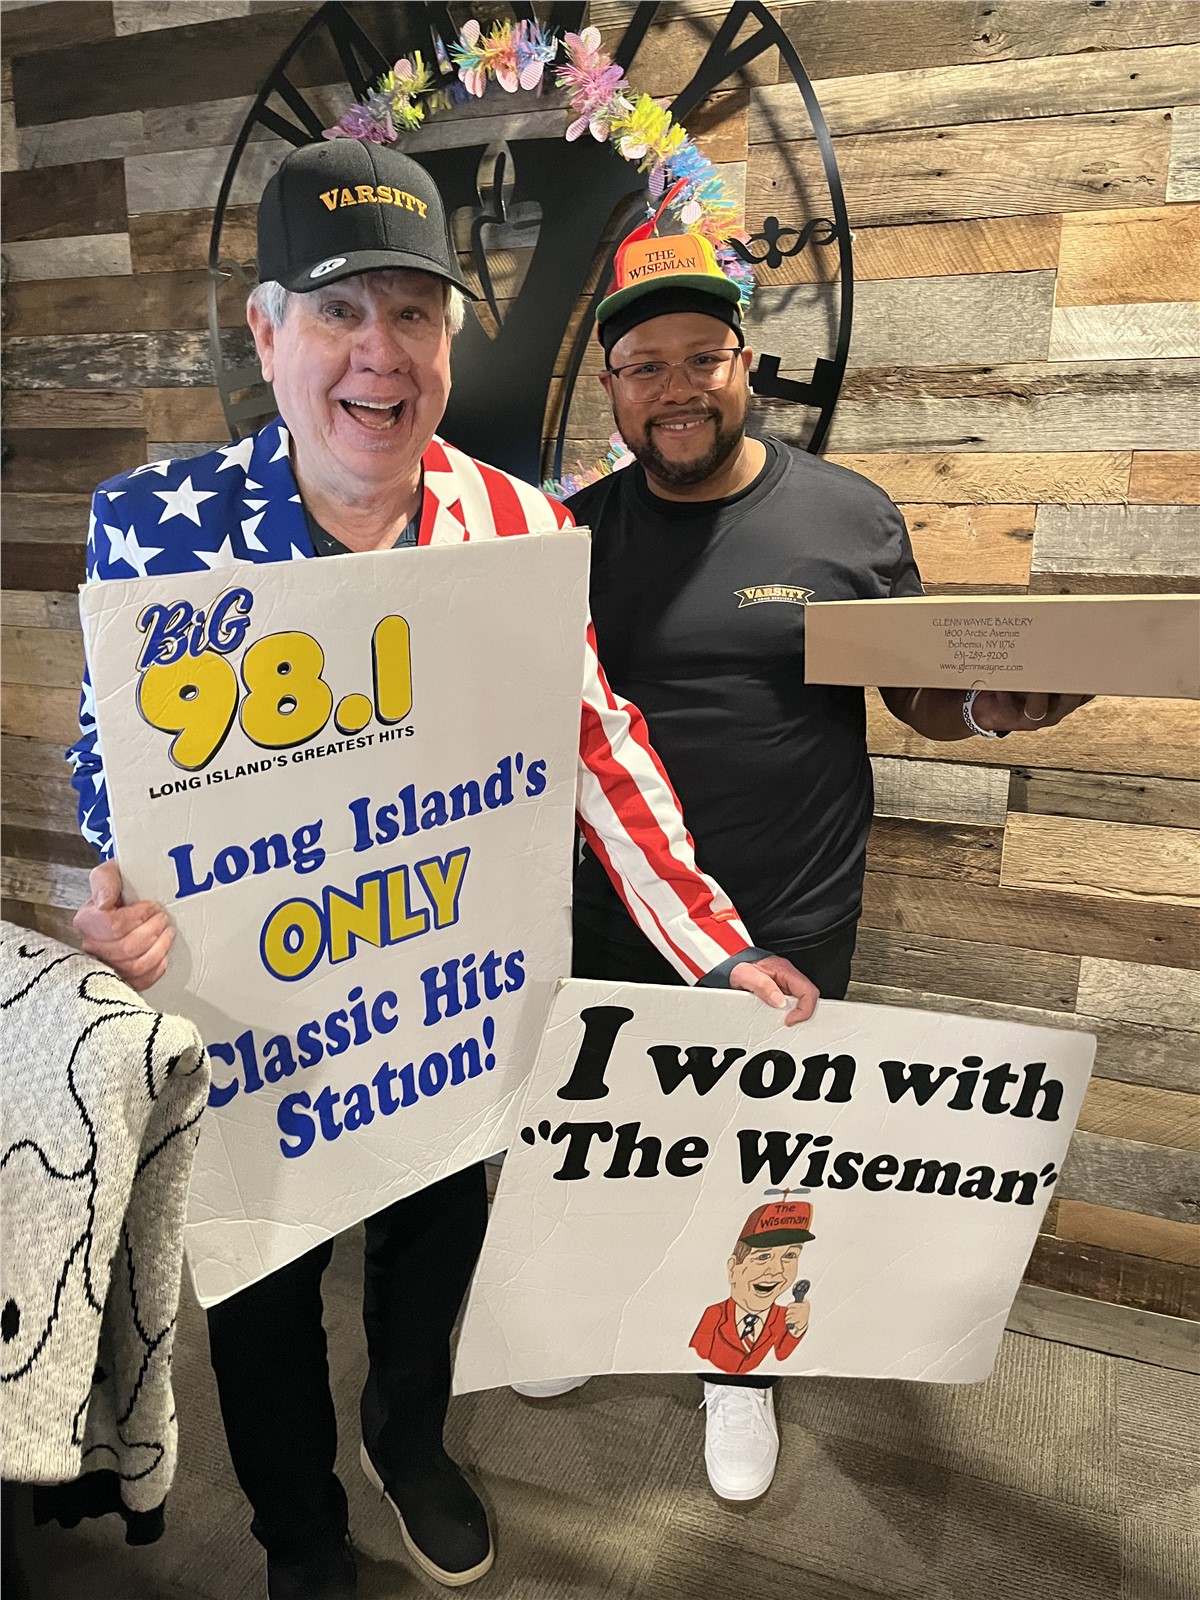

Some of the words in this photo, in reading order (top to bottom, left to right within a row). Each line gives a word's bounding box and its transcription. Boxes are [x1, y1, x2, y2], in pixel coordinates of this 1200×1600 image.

[319, 185, 428, 219] VARSITY
[645, 249, 676, 263] THE
[629, 258, 696, 280] WISEMAN
[744, 587, 805, 599] VARSITY
[932, 618, 962, 627] GLENN
[963, 617, 993, 626] WAYNE
[995, 617, 1034, 626] BAKERY
[944, 629, 963, 637] 1800
[964, 629, 988, 637] Arctic
[989, 629, 1020, 637] Avenue
[986, 640, 998, 648] NY
[940, 661, 1023, 674] www.glennwayne.com
[136, 614, 412, 771] 98.1
[149, 776, 202, 799] LONG
[206, 755, 288, 785] ISLAND'S
[291, 735, 375, 763] GREATEST
[379, 725, 415, 743] HITS
[168, 819, 326, 899] Long
[348, 752, 547, 852] Island's
[260, 846, 471, 982] ONLY
[206, 986, 399, 1108] Classic
[420, 949, 526, 1027] Hits
[557, 1006, 634, 1100] I
[646, 1044, 857, 1103] won
[878, 1055, 1065, 1122] with
[277, 1016, 496, 1159] Station!
[774, 1204, 796, 1214] The
[761, 1216, 808, 1228] Wiseman
